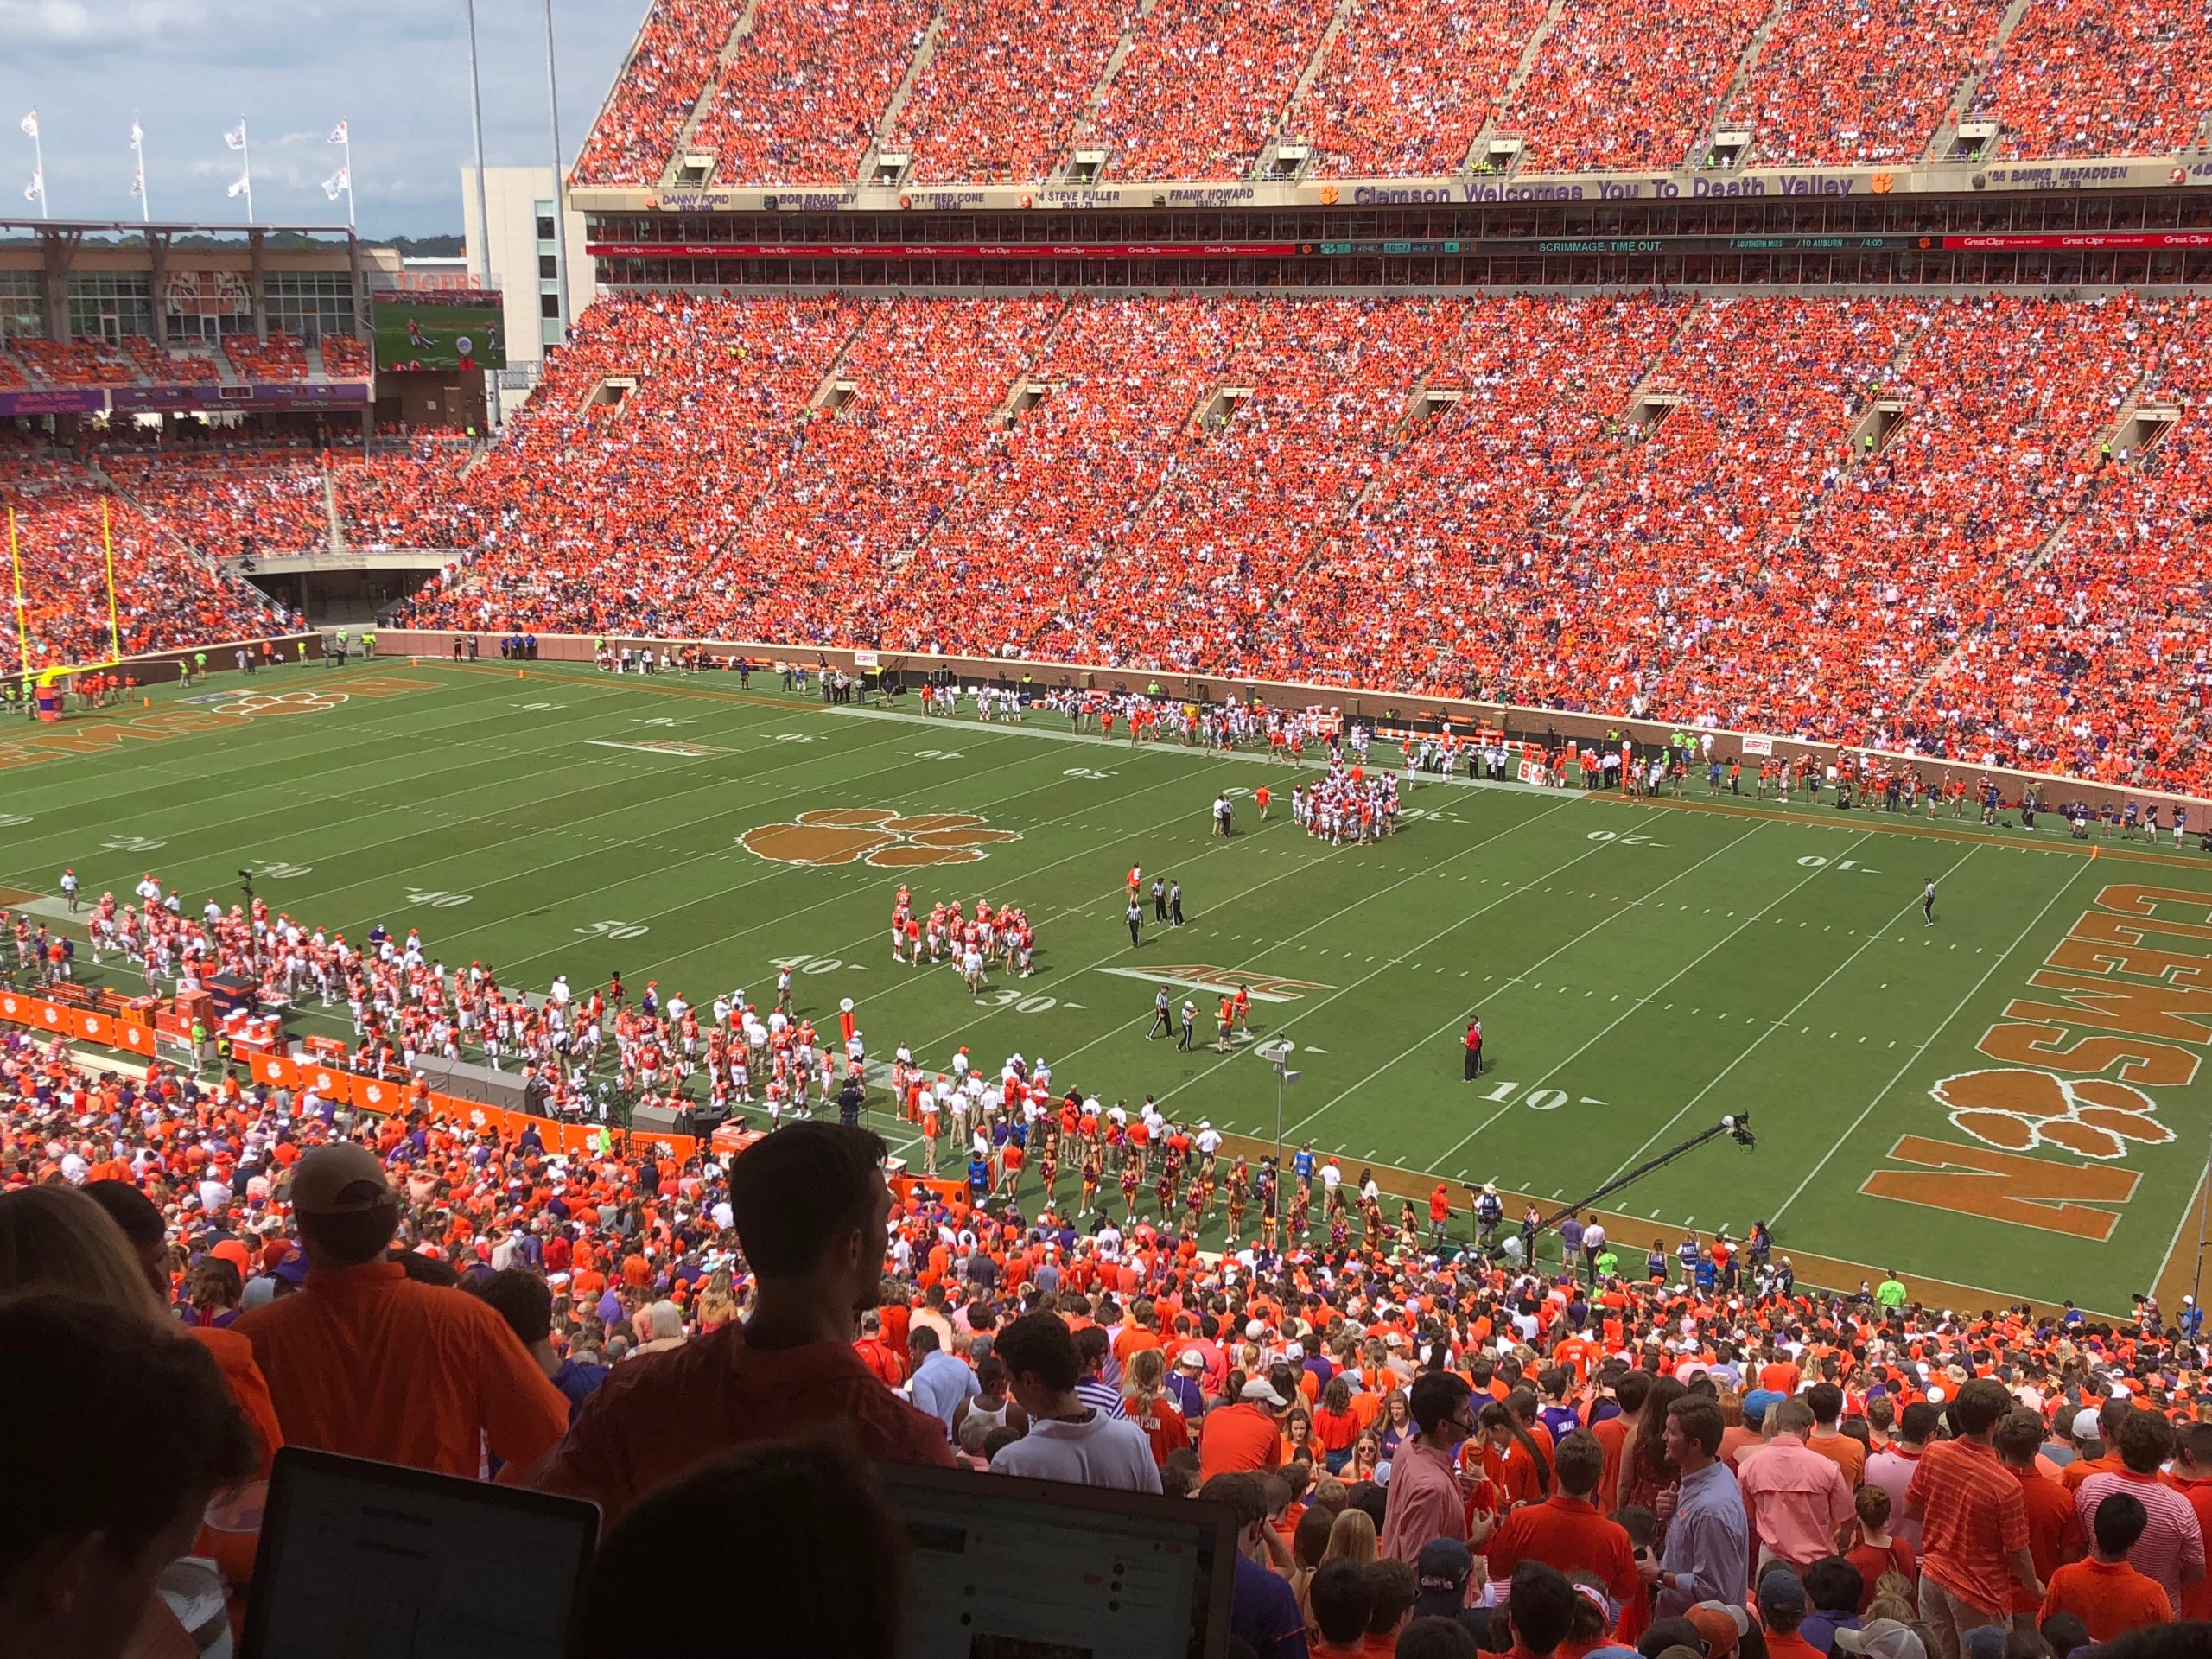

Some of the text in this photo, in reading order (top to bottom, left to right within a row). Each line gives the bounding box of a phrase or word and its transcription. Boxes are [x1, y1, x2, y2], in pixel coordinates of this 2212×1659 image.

[2011, 168, 2052, 182] BANKS
[2059, 166, 2128, 181] McFADDEN
[1048, 191, 1078, 201] STEVE
[1082, 191, 1120, 201] FULLER
[1169, 188, 1255, 200] FRANK HOWARD
[1354, 174, 1853, 206] Clemson Welcomes You To Death Valley
[663, 194, 729, 205] DANNY FORD
[779, 194, 857, 205] BOB BRADLEY
[928, 193, 954, 203] FRED
[957, 193, 985, 203] CONE
[1737, 239, 1783, 248] SOUTHERN MISS
[1986, 238, 2005, 246] Clips
[2085, 237, 2105, 245] Clips
[2164, 235, 2209, 245] Great Clips
[1539, 241, 1662, 252] SCRIMMAGE. TIME OUT.
[397, 271, 481, 291] TIGERS
[1520, 763, 1529, 779] S
[573, 919, 649, 939] 50
[768, 954, 842, 975] 40
[1121, 963, 1339, 1000] ACC
[974, 989, 1057, 1013] 30
[1476, 1081, 1569, 1110] 10
